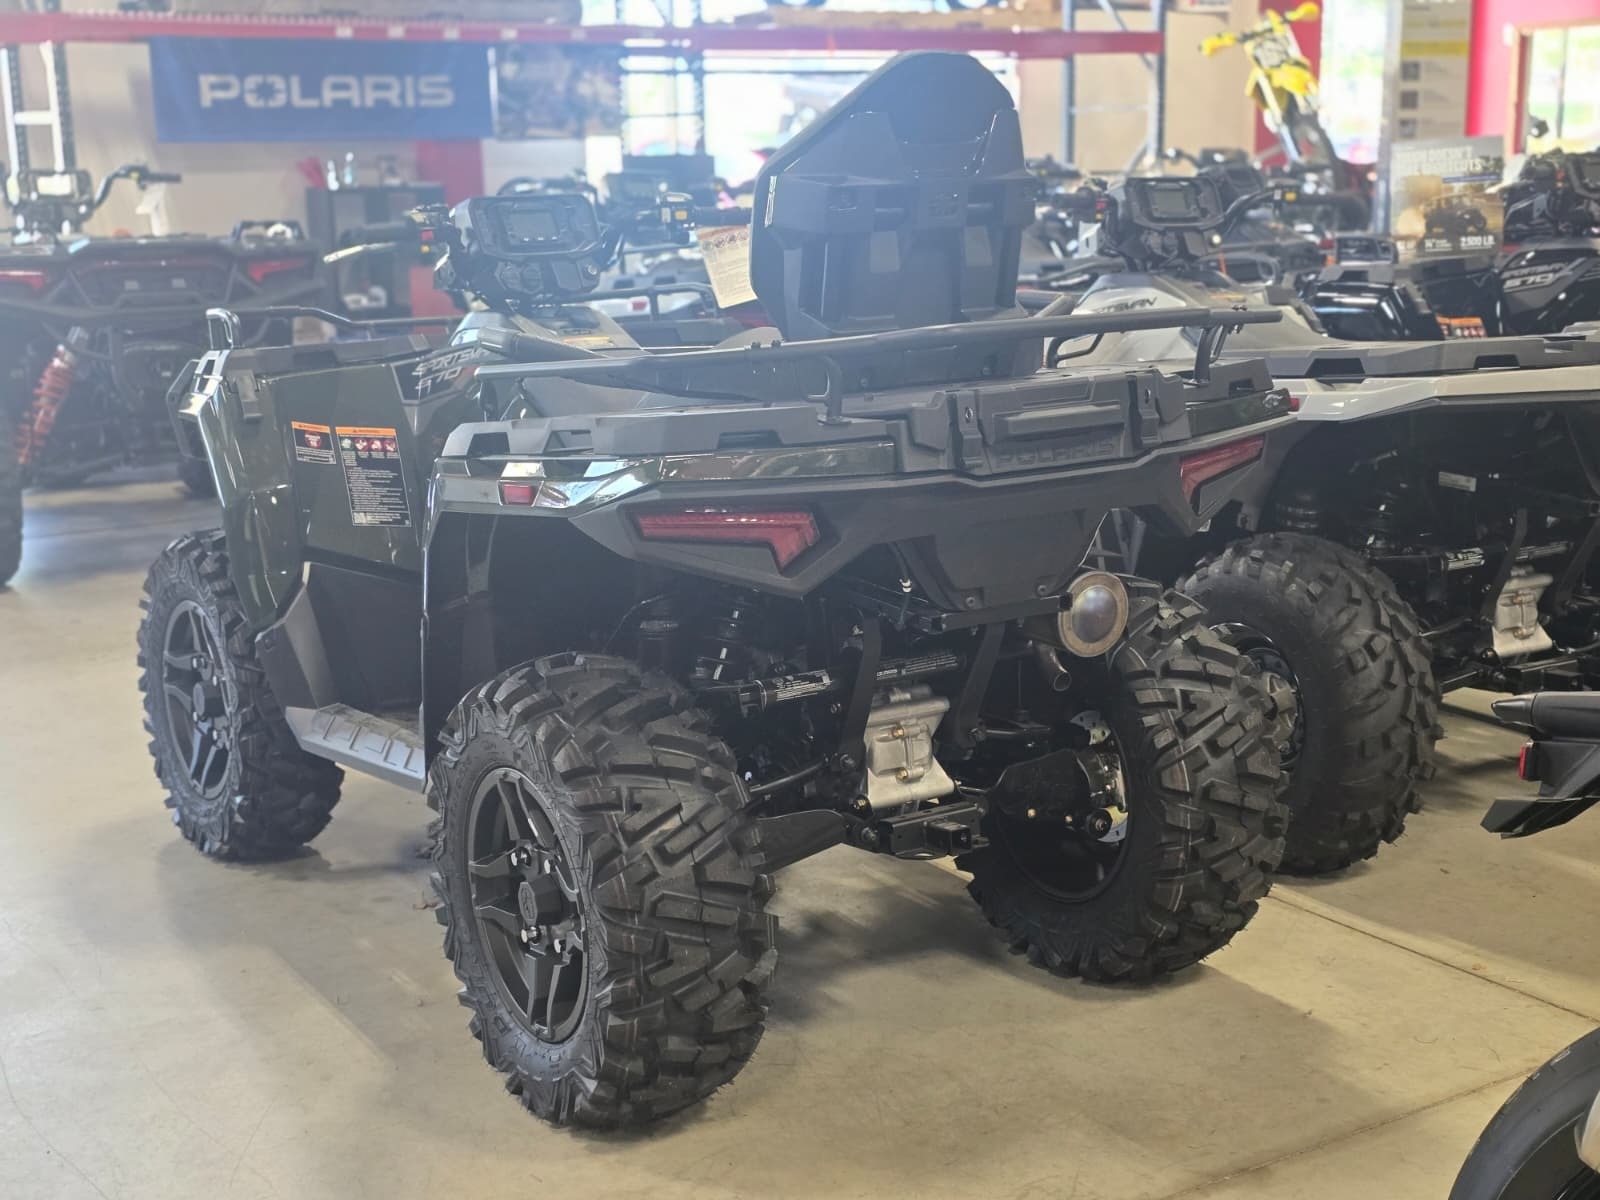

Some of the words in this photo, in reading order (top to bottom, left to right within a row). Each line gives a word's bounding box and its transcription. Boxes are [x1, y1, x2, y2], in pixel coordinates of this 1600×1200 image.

[198, 75, 454, 108] POLARIS
[1503, 273, 1554, 290] 570
[998, 440, 1114, 467] POLARIS
